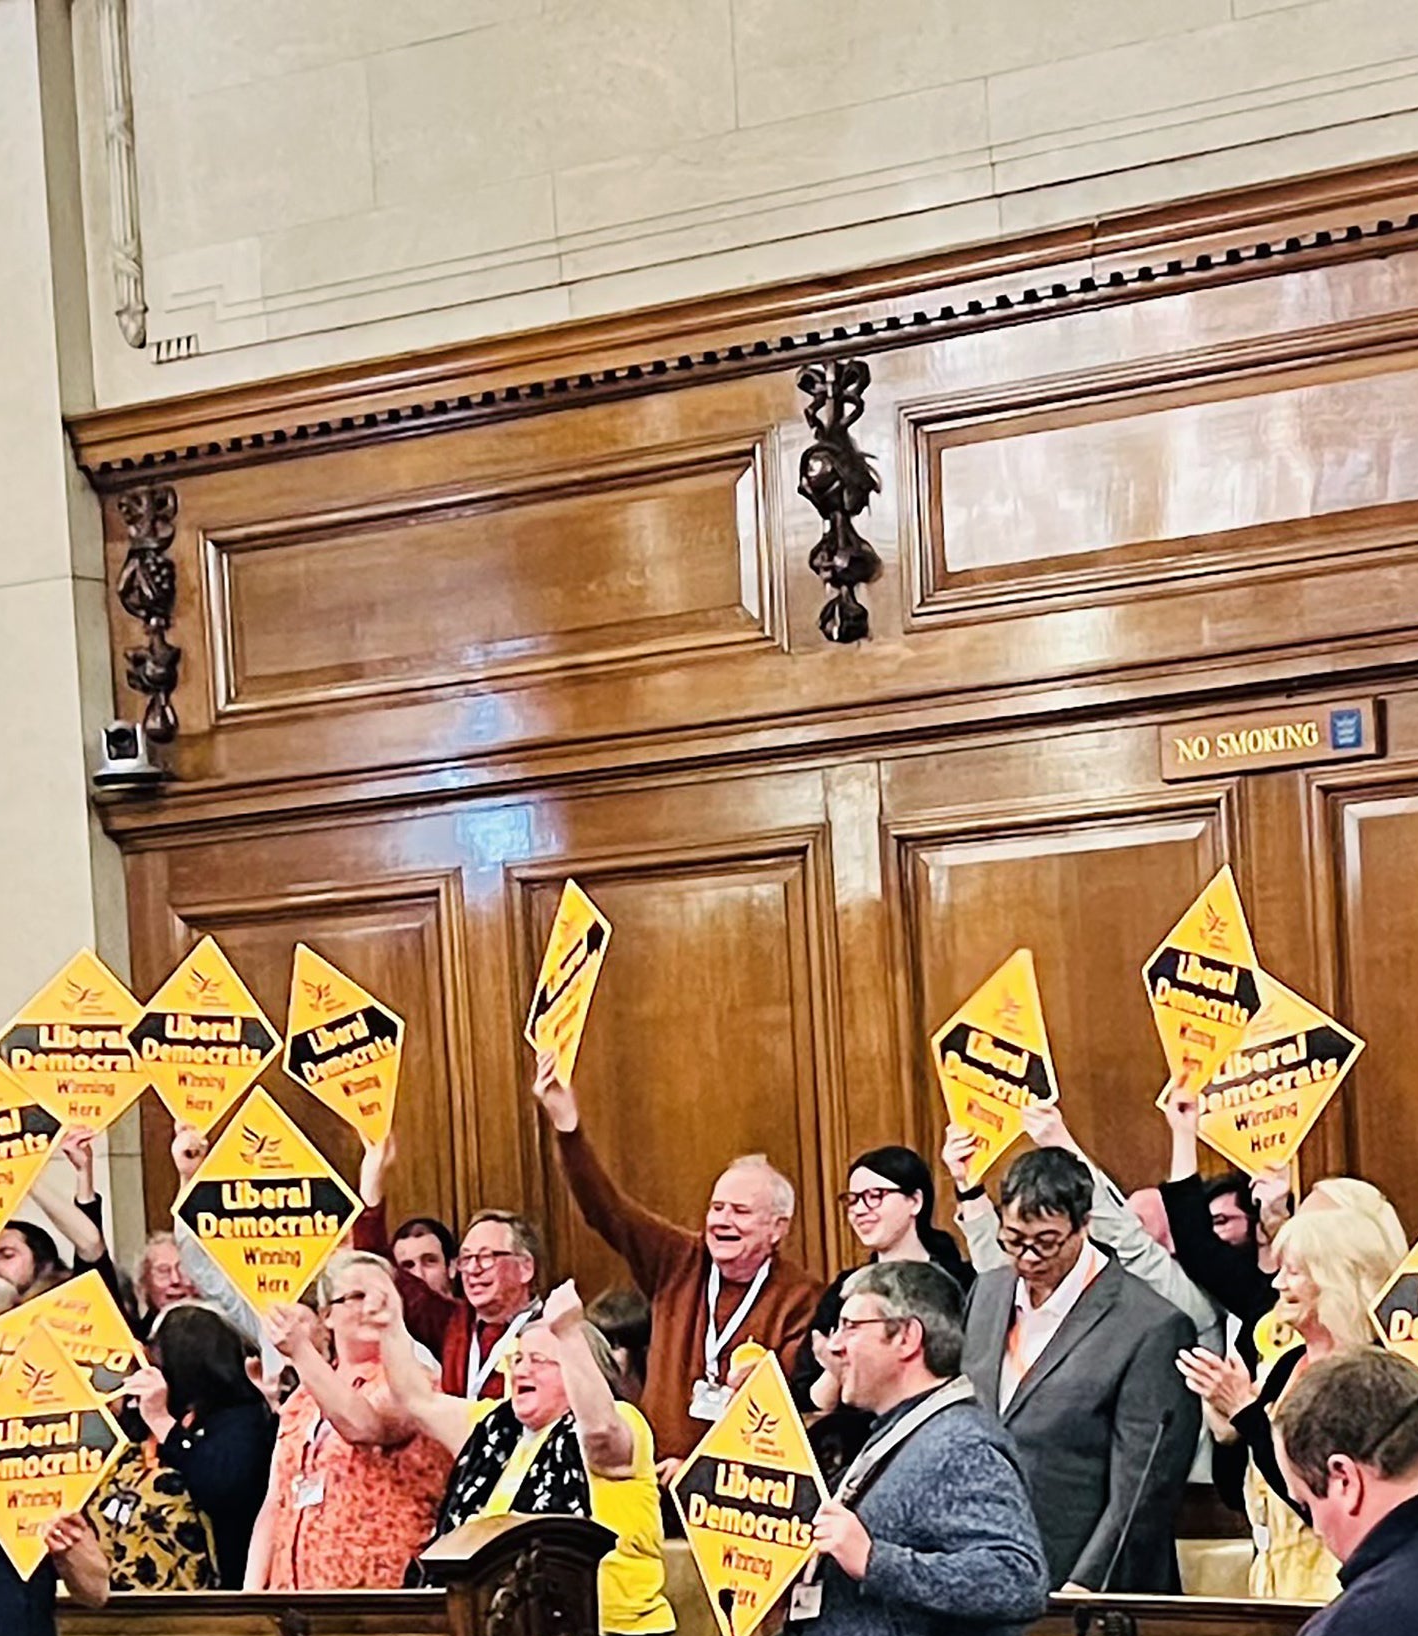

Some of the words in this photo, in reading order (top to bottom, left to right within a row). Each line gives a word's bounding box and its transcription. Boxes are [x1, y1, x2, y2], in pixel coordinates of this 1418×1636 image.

[1173, 735, 1210, 763] NO
[1216, 722, 1319, 758] SMOKING
[1176, 954, 1238, 995] Liberal
[1155, 976, 1249, 1028] Democrats
[165, 1014, 242, 1042] Liberal
[307, 1012, 370, 1055] Liberal
[142, 1037, 262, 1065] Democrats
[301, 1035, 396, 1086] Democrats
[1212, 1032, 1307, 1085] Liberal
[57, 1078, 116, 1097] Winning
[68, 1102, 102, 1117] Here
[1234, 1101, 1298, 1131] Winning
[1251, 1131, 1286, 1152] Here
[222, 1179, 311, 1210] Liberal
[197, 1210, 338, 1238] Democrats
[244, 1246, 302, 1268] Winning
[257, 1274, 289, 1292] Here
[7, 1488, 63, 1509] Winning
[715, 1464, 796, 1509] Liberal
[688, 1493, 813, 1550] Democrats
[722, 1544, 773, 1581] Winning
